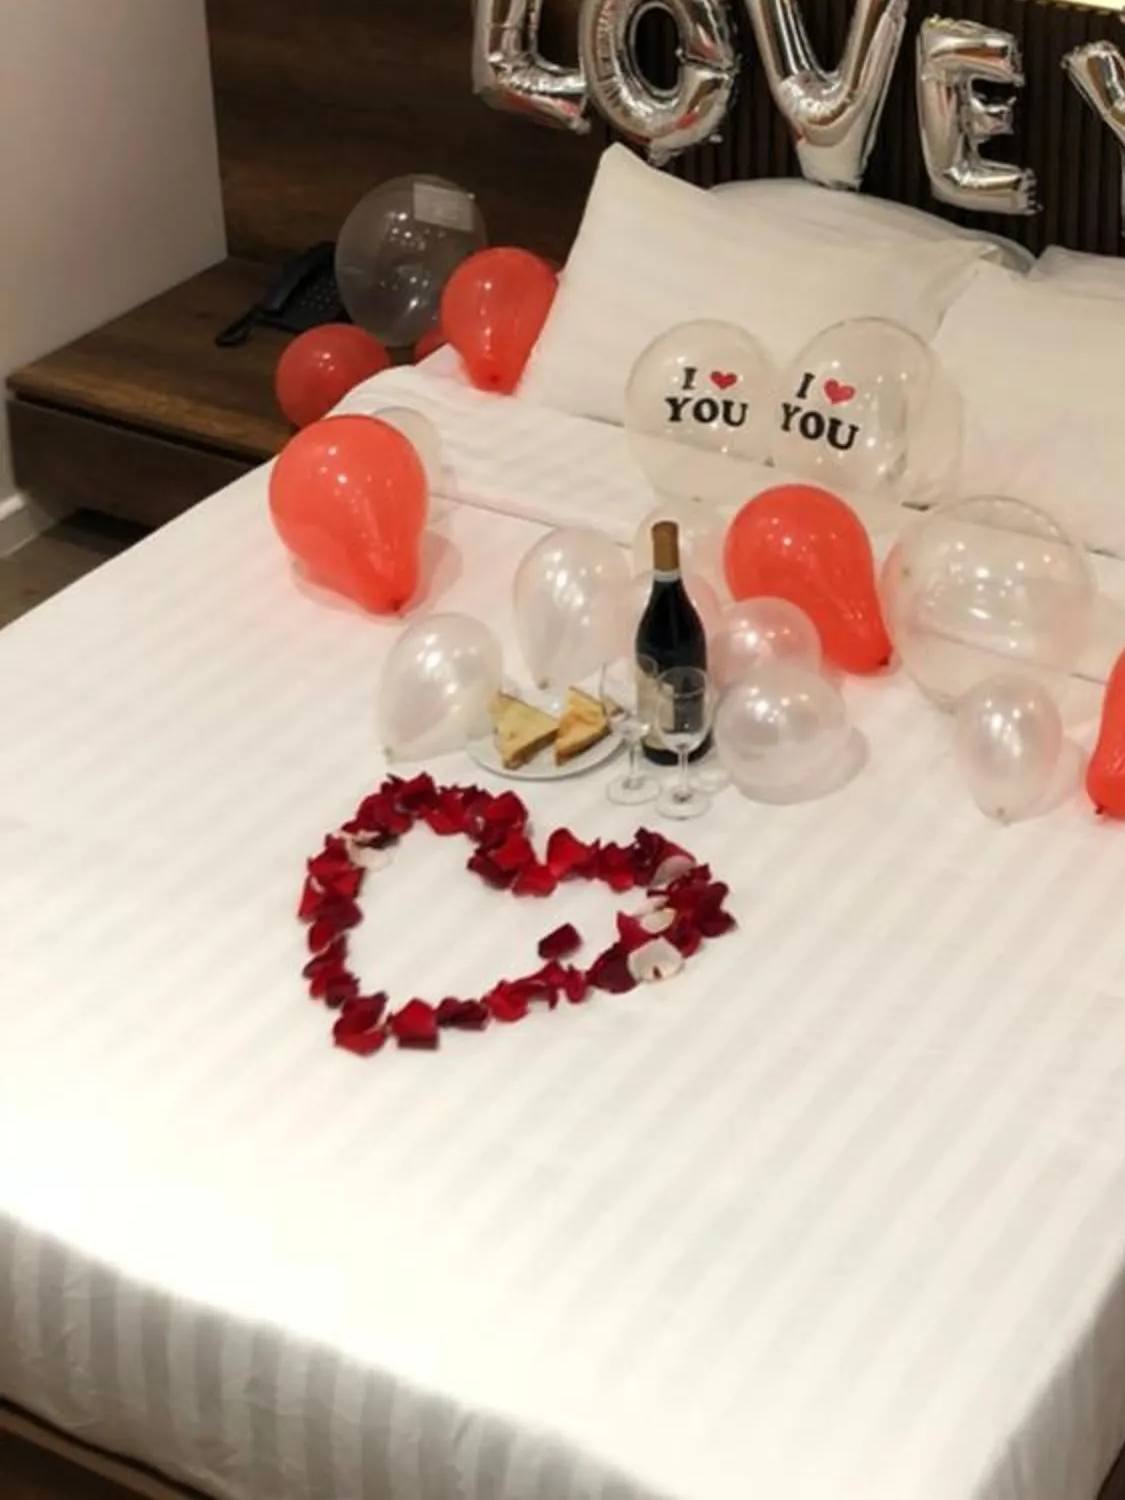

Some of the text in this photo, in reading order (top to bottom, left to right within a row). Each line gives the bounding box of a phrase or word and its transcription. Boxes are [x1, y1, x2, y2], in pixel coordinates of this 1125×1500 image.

[682, 366, 697, 391] I
[795, 372, 815, 400] I
[665, 396, 748, 427] YOU
[781, 402, 860, 451] YOU
